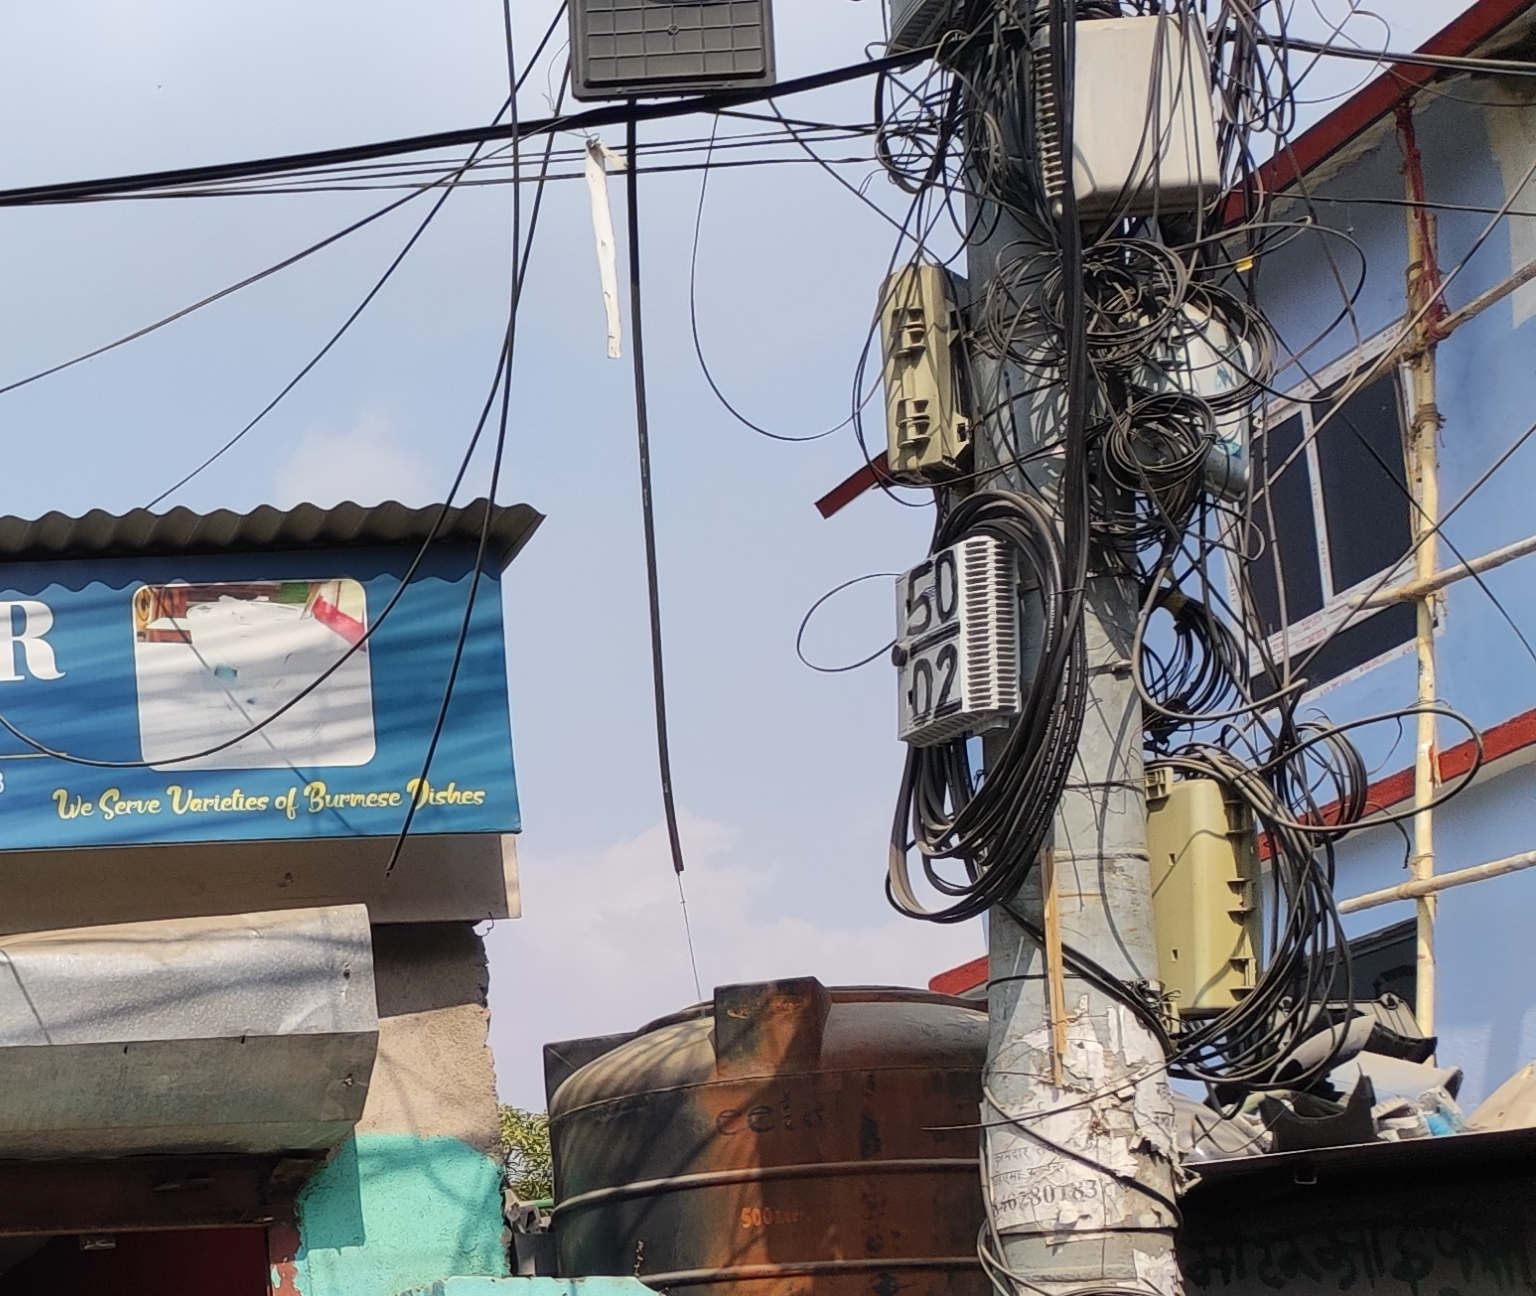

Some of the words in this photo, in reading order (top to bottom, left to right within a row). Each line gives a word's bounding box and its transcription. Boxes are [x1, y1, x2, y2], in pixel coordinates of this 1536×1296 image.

[52, 788, 94, 820] We
[99, 788, 162, 820] Serve
[167, 784, 268, 816] Varieties
[275, 786, 298, 821] of
[304, 781, 400, 813] Burmese
[406, 777, 486, 810] Dishes
